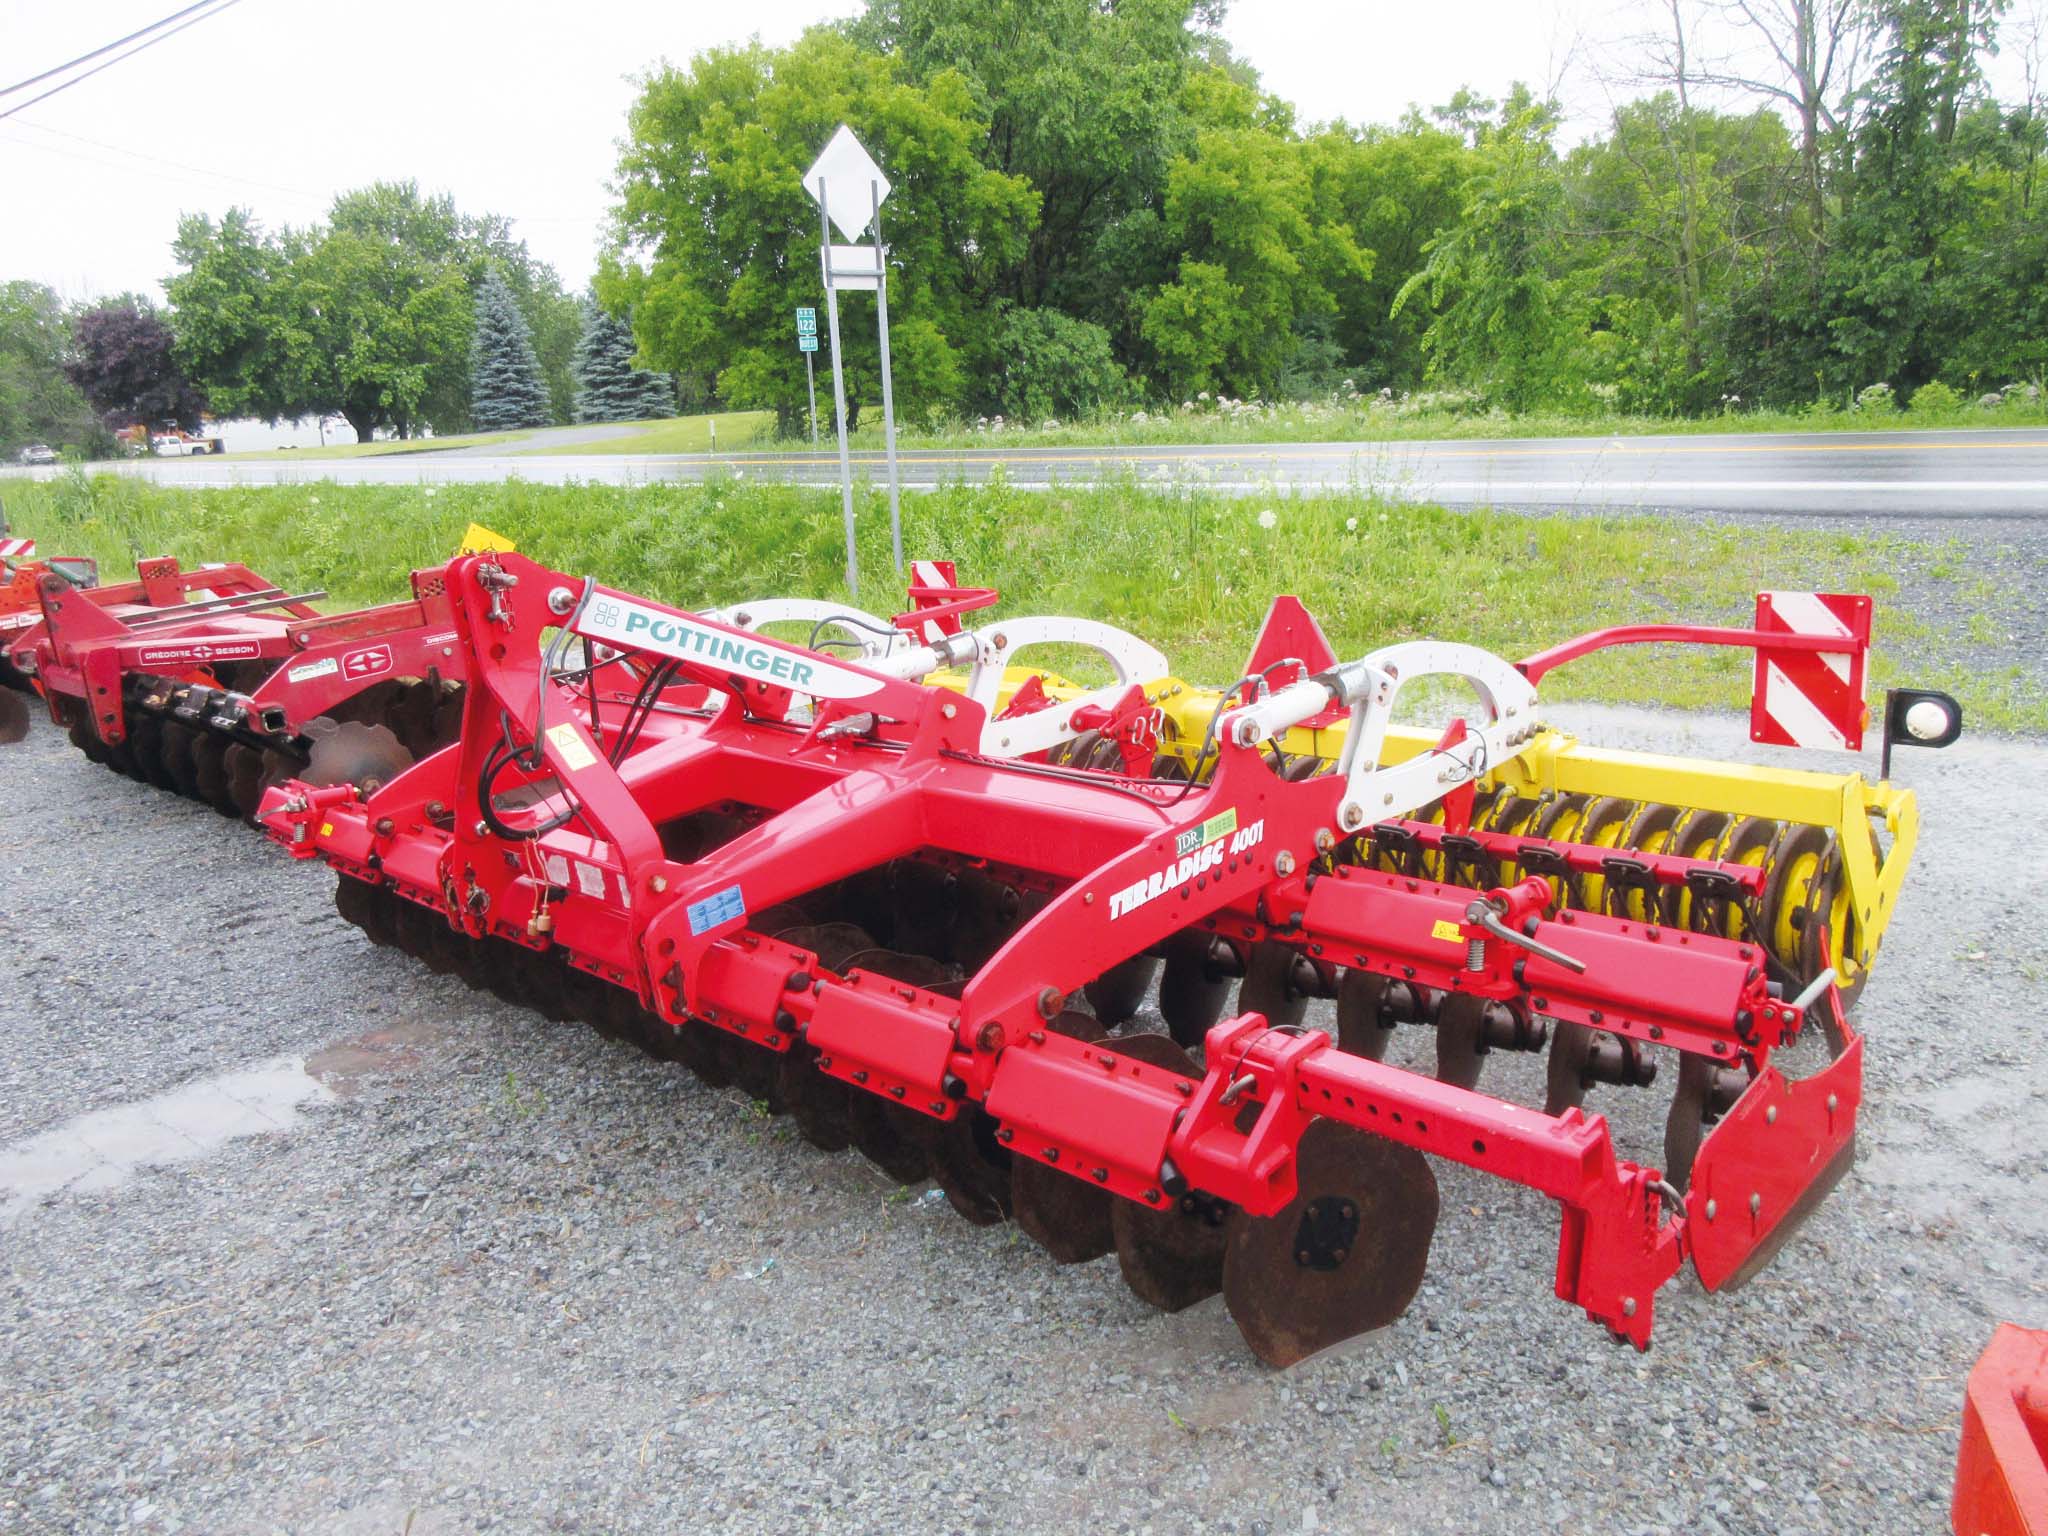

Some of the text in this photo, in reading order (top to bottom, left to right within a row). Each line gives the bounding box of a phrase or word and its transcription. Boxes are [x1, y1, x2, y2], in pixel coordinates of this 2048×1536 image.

[799, 320, 815, 331] 122
[215, 646, 254, 655] BESSON
[1109, 838, 1225, 921] TERRADISC
[1229, 818, 1265, 856] 4001
